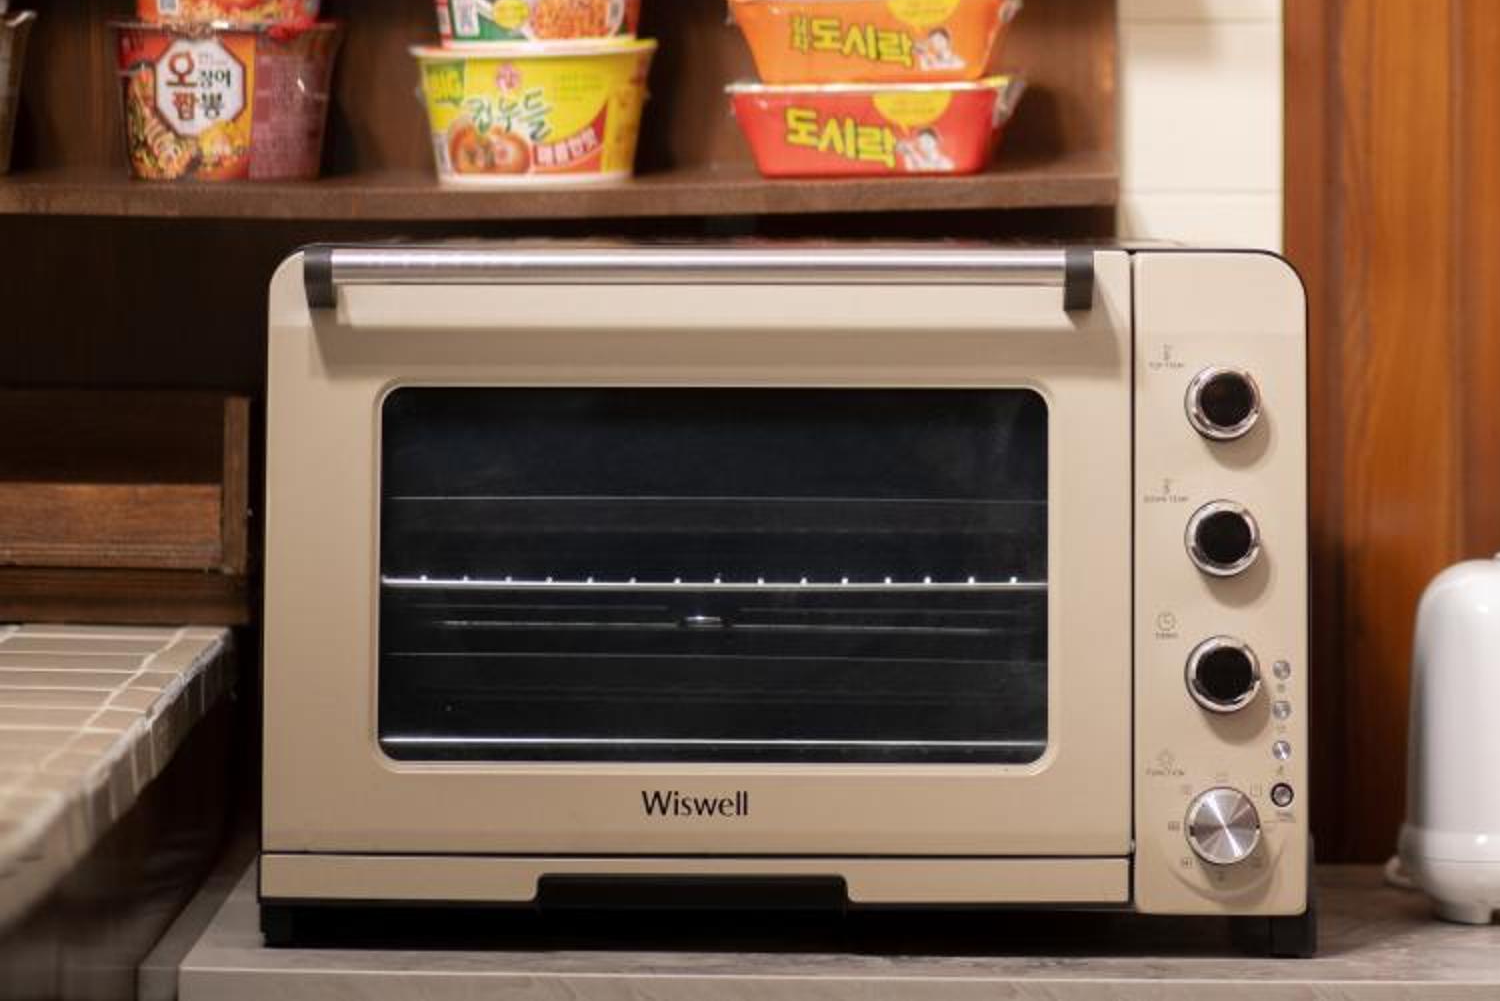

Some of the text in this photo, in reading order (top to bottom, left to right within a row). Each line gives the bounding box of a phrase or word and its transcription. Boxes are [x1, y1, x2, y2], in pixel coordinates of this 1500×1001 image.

[810, 16, 914, 68] 도시락
[165, 50, 232, 88] 오징어
[170, 91, 225, 122] 짬뽕
[785, 106, 896, 167] 도시락
[641, 790, 748, 817] Wiswell
